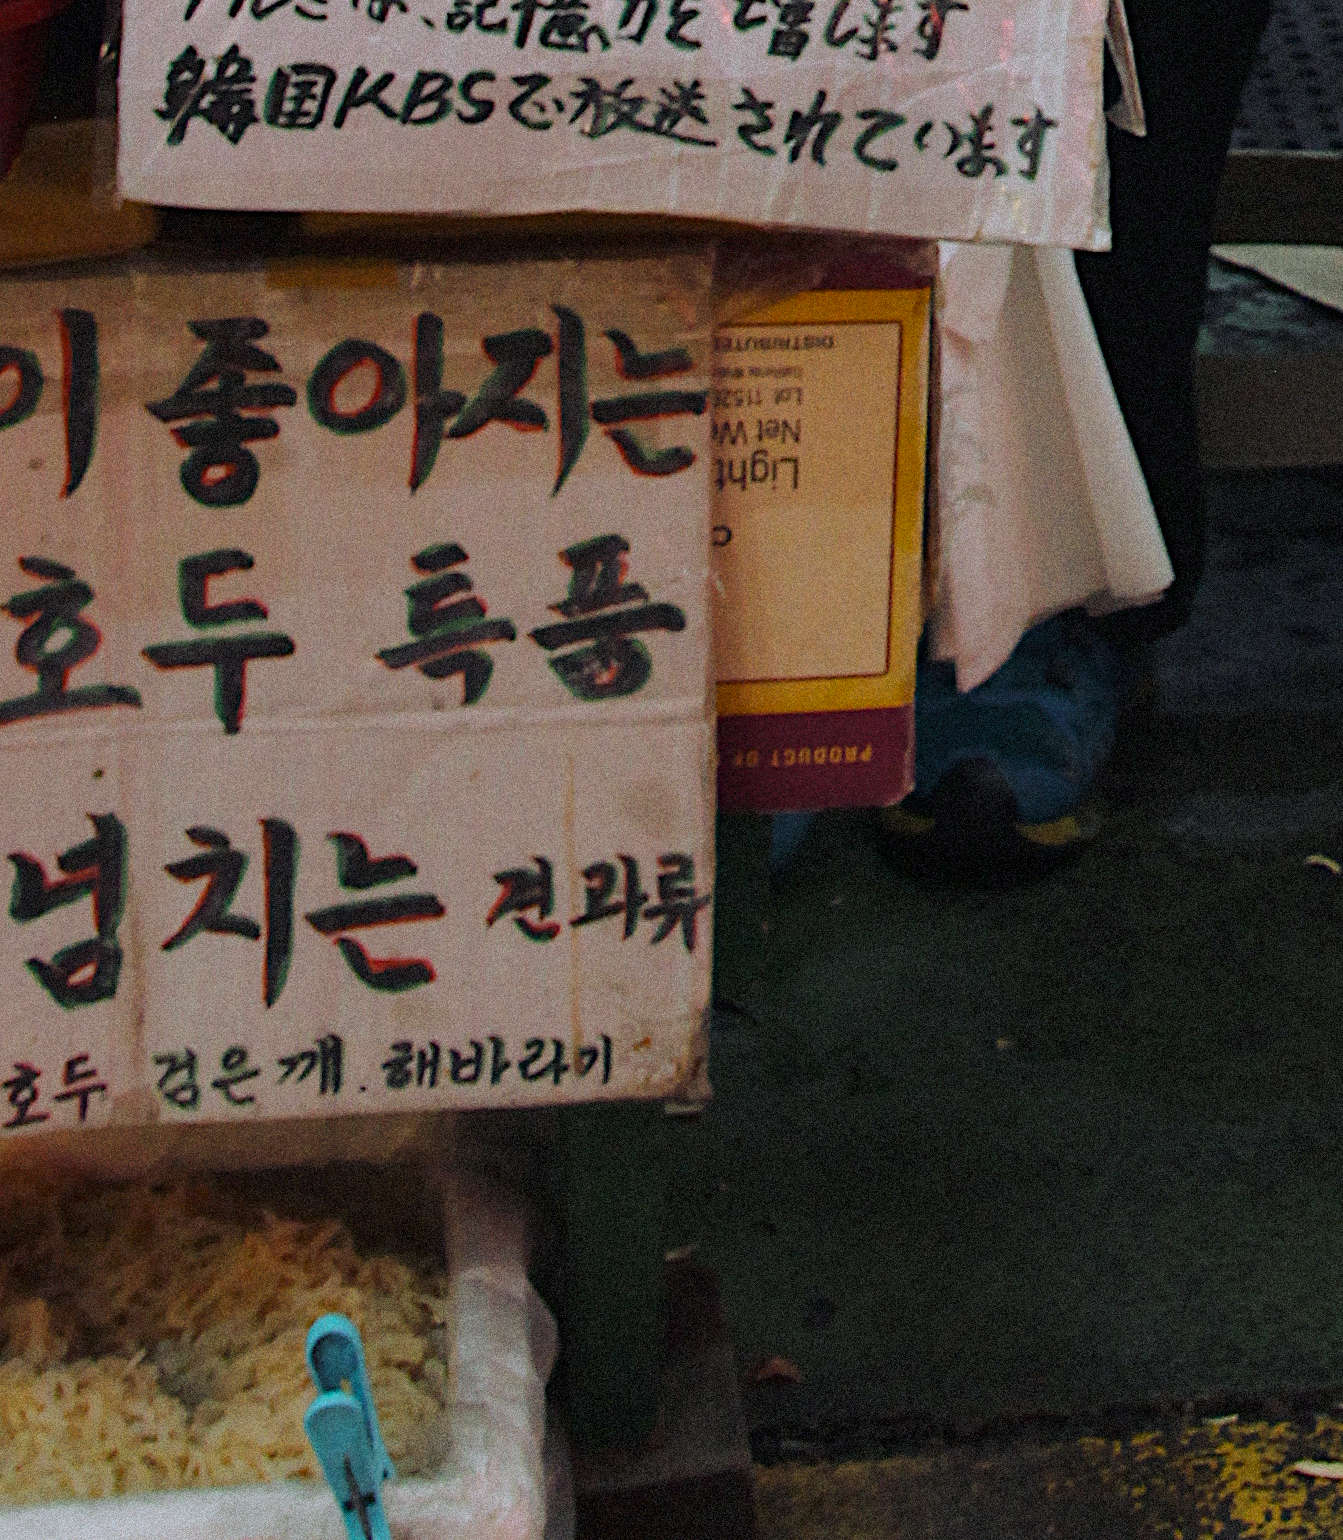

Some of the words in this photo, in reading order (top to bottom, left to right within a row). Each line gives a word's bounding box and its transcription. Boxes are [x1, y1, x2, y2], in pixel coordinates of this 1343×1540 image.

[145, 303, 710, 508] 좋아지는
[714, 449, 801, 491] Light
[755, 418, 802, 444] Net
[0, 547, 296, 735] 호두
[376, 532, 687, 707] 특품
[6, 810, 447, 1010] 넘치는
[485, 851, 709, 951] 견과류
[1, 1053, 108, 1131] 호두
[382, 1032, 613, 1089] 해바라기
